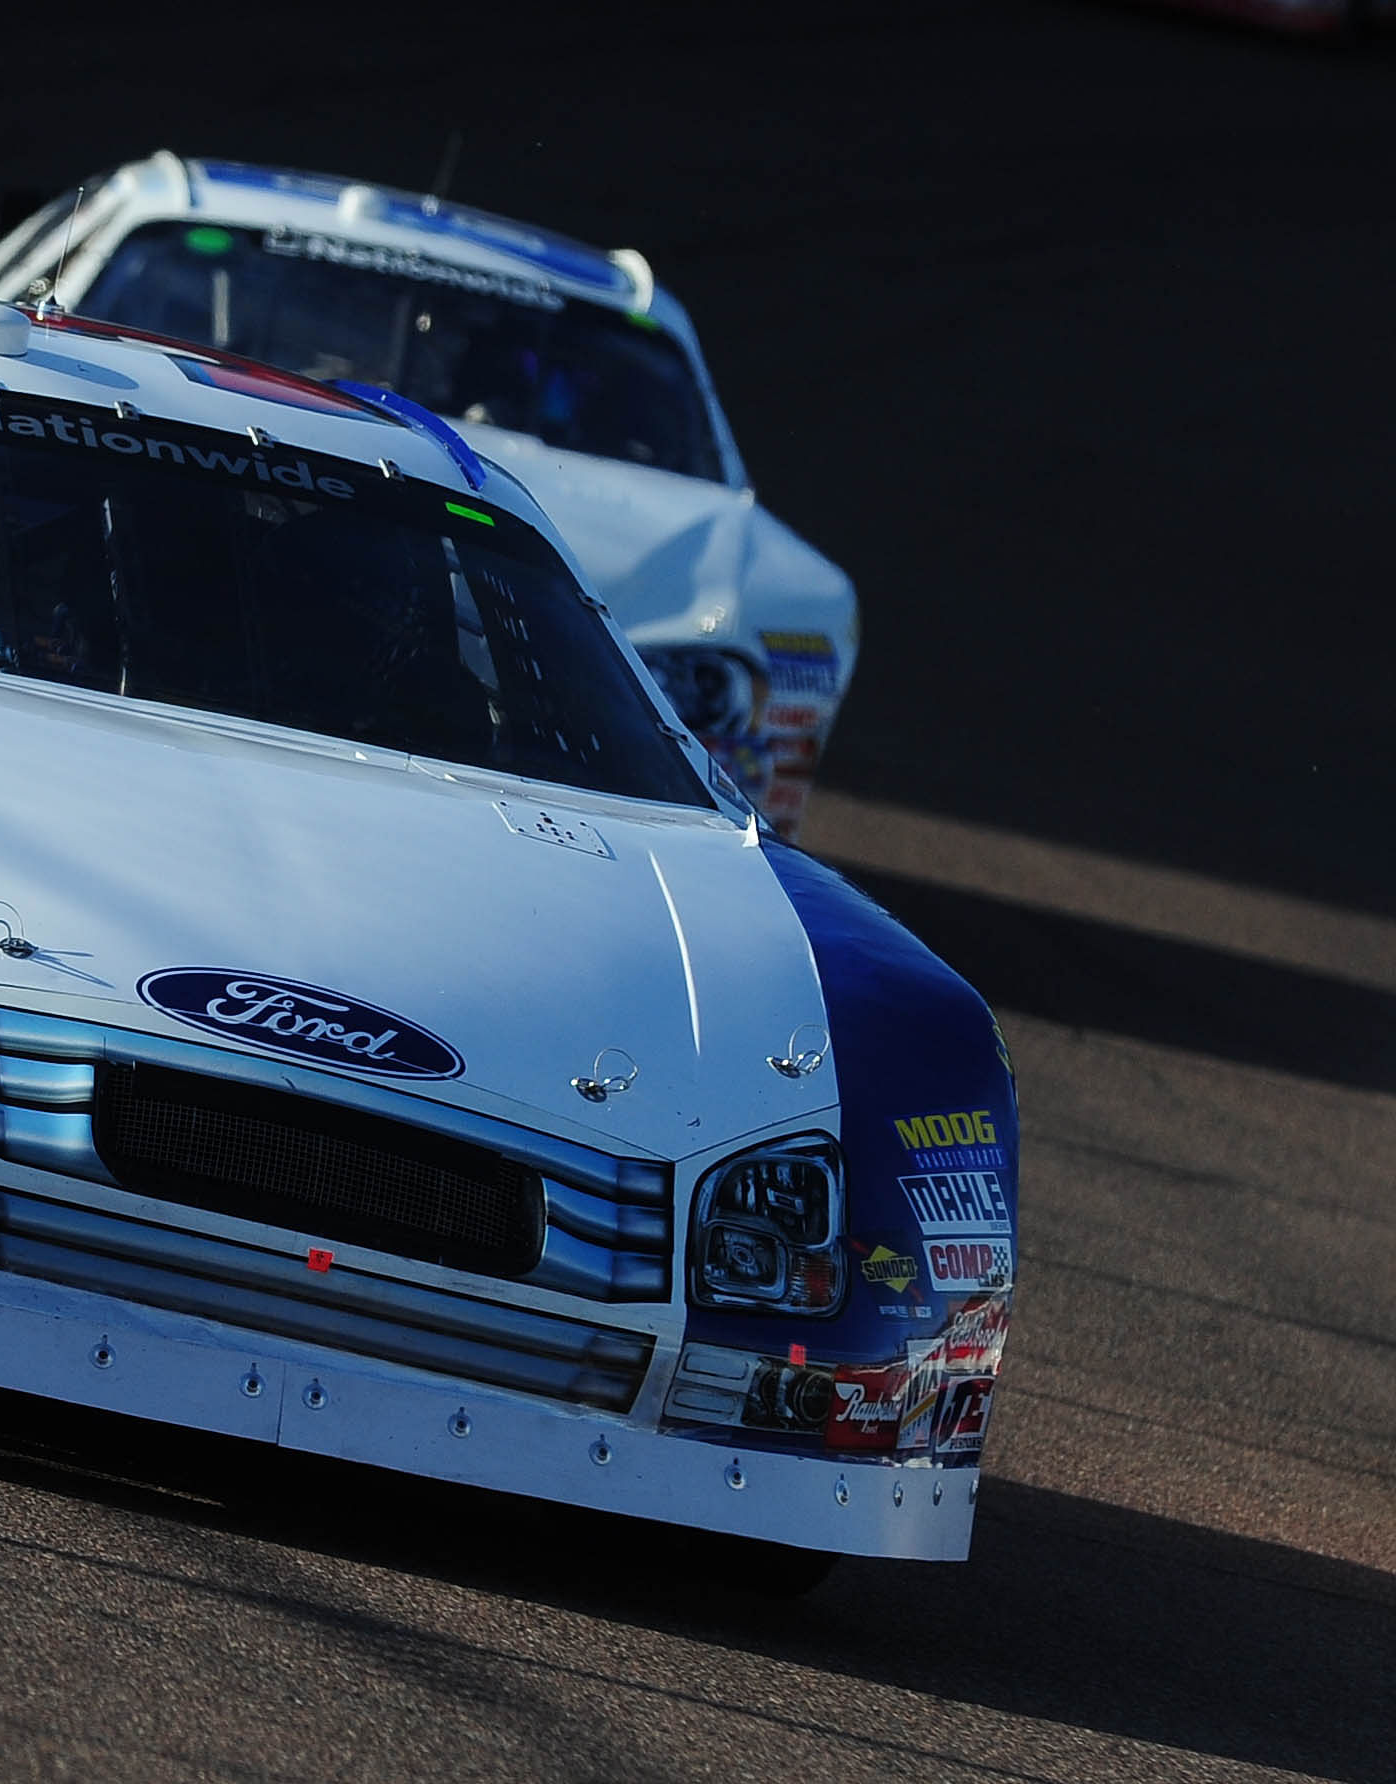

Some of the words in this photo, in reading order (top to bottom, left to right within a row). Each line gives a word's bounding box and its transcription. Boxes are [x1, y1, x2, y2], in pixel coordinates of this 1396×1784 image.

[205, 980, 399, 1060] Ford
[893, 1110, 997, 1150] MOOG
[900, 1174, 1009, 1223] MAHLE
[862, 1257, 917, 1281] SUNOCO
[929, 1243, 993, 1281] COMP
